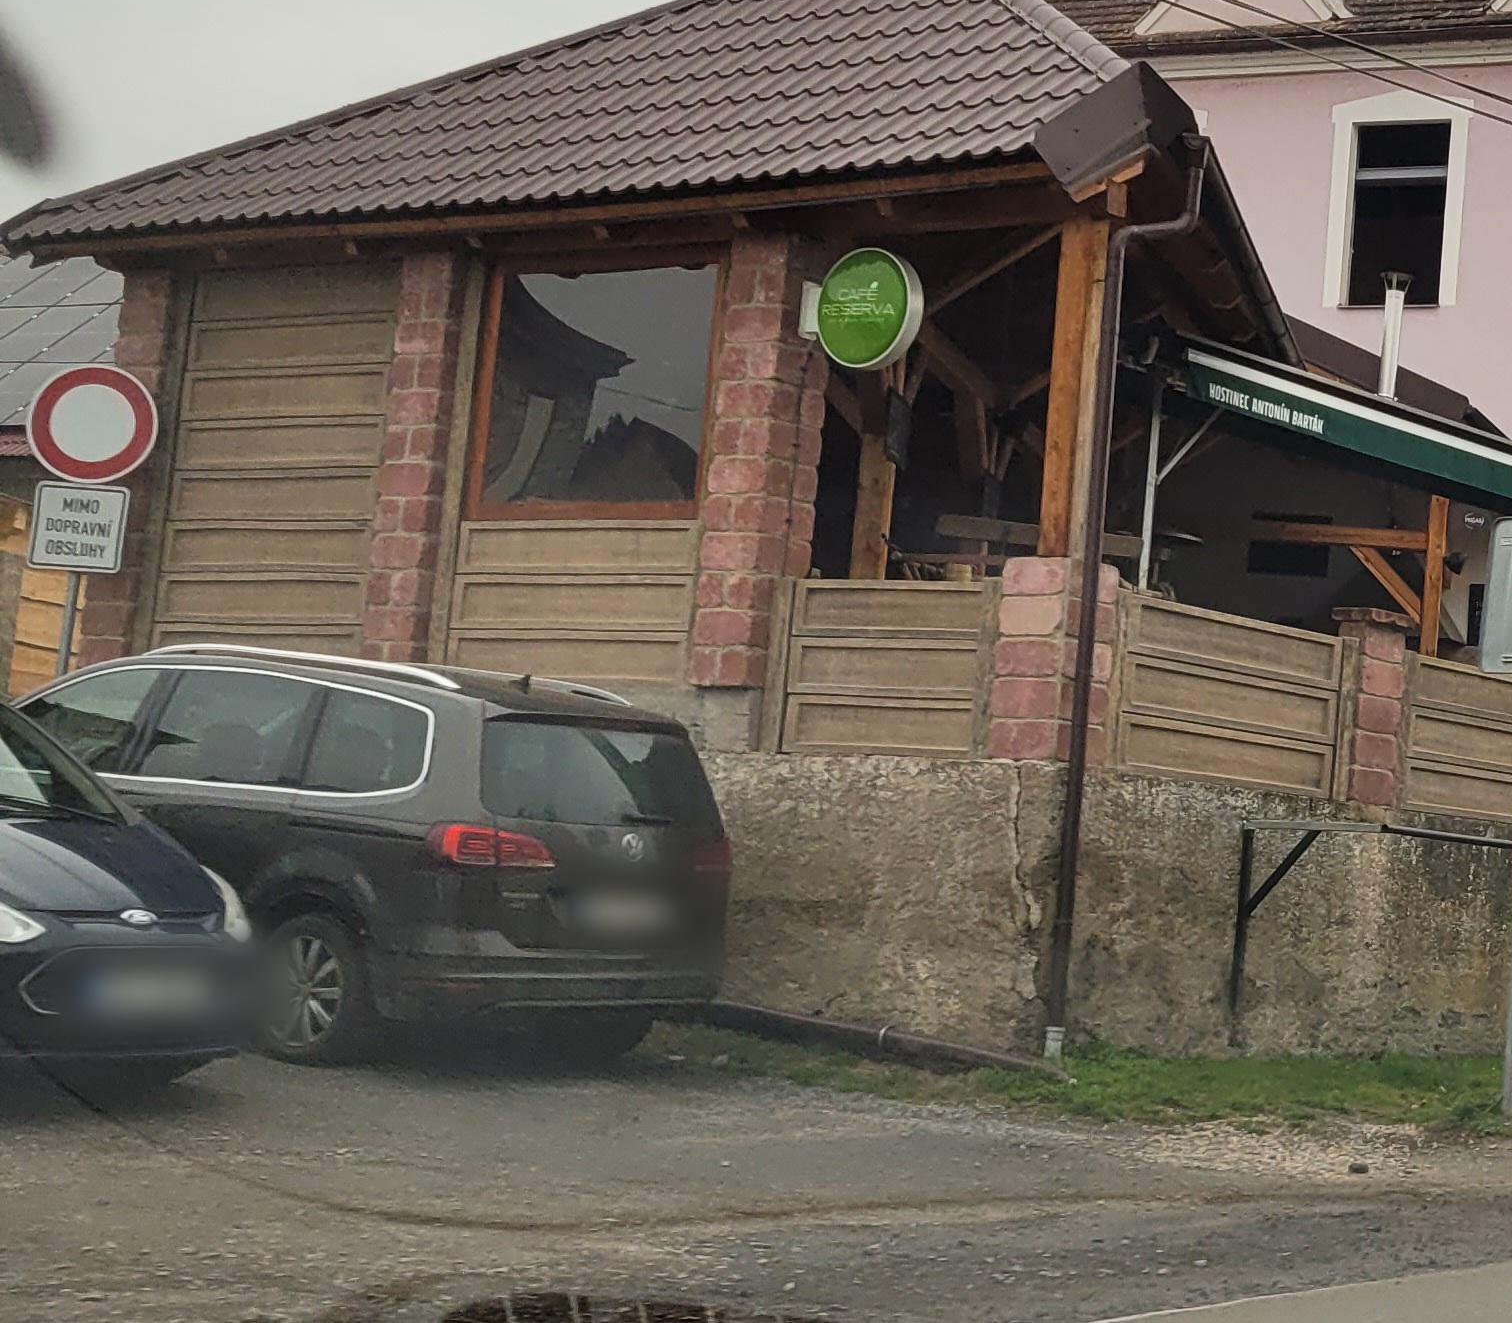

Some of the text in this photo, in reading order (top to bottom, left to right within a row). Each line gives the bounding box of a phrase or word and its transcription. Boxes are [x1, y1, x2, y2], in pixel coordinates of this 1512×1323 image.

[822, 302, 895, 316] RESERVA
[1208, 382, 1325, 435] HOSTINEC ANTONÍN BARTÁK
[61, 496, 100, 515] MIMO
[45, 517, 113, 539] DOPRAVNÍ
[44, 539, 107, 559] OBSLUHY
